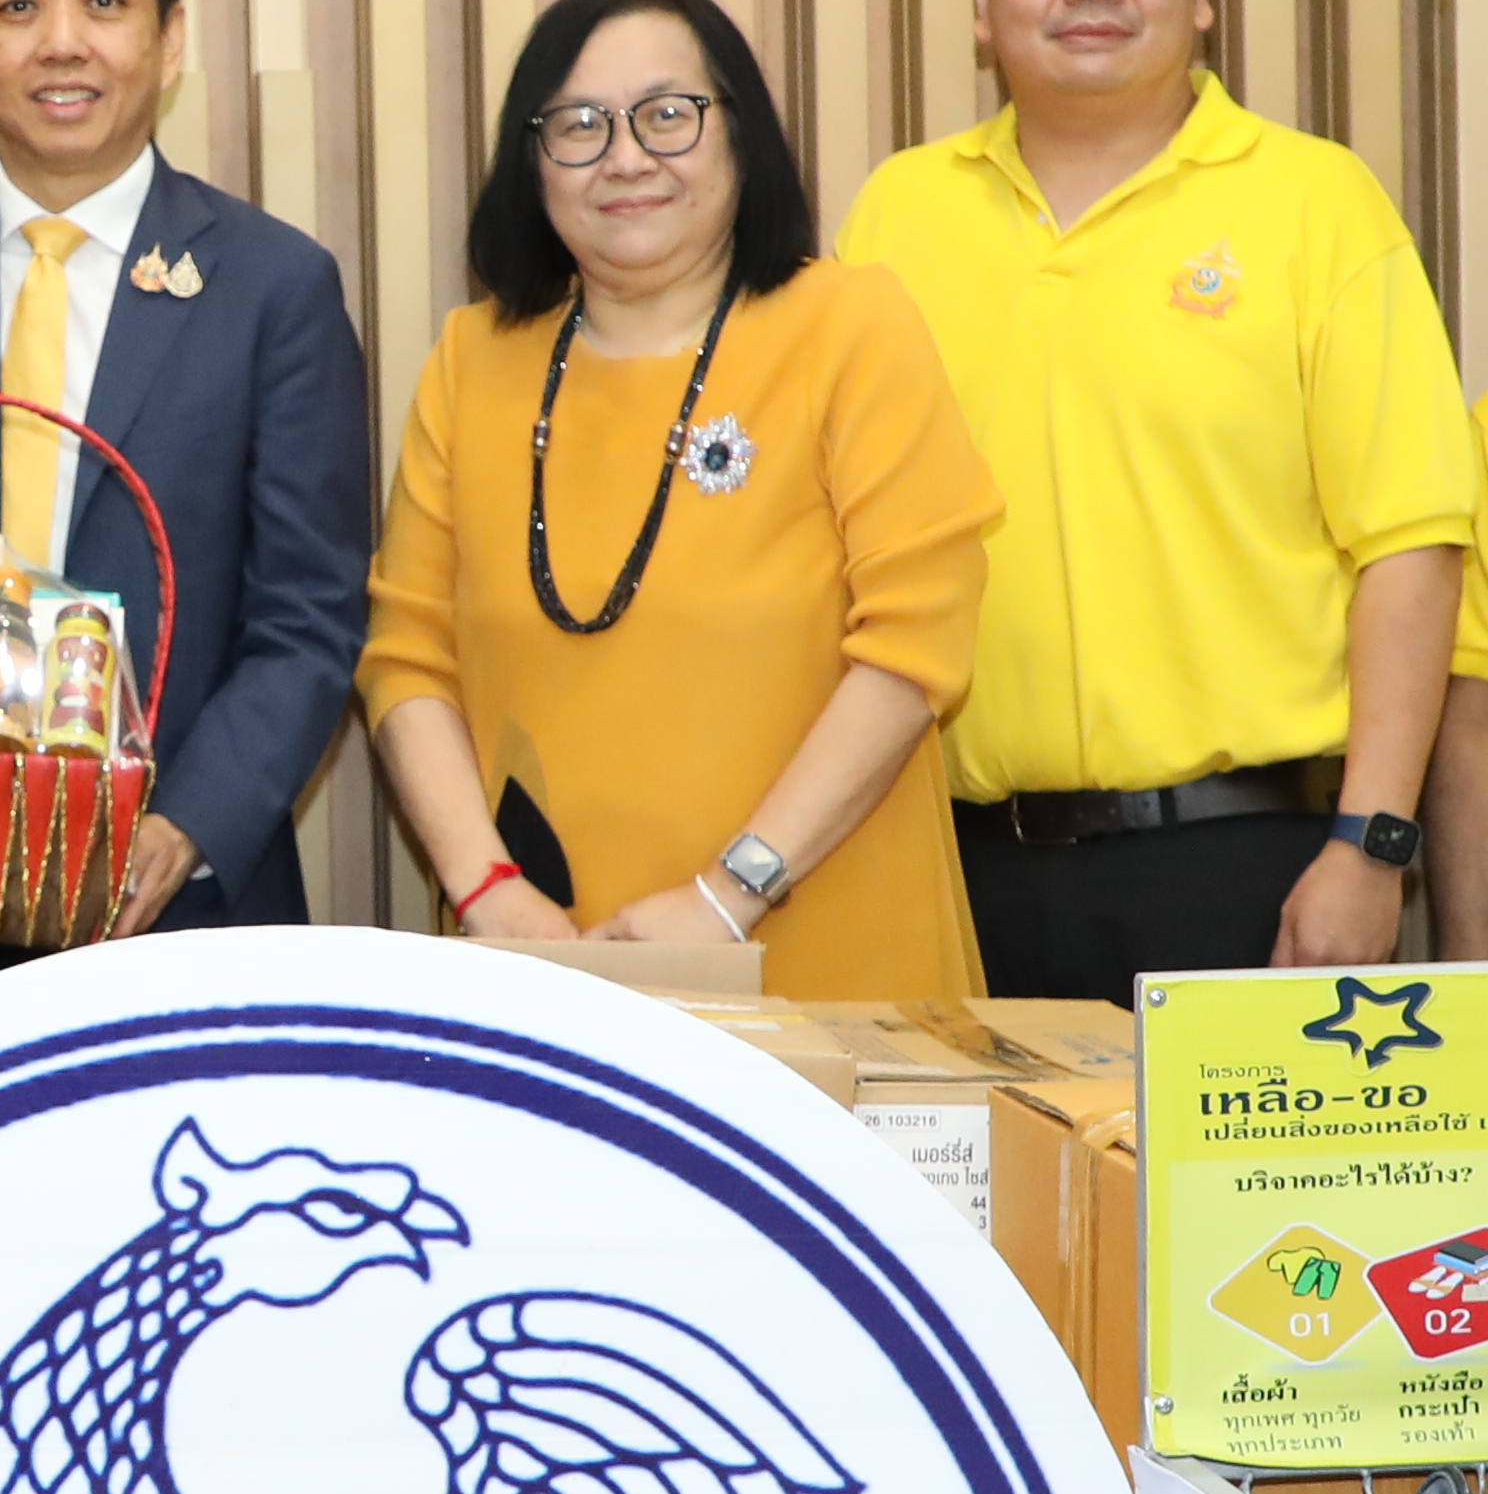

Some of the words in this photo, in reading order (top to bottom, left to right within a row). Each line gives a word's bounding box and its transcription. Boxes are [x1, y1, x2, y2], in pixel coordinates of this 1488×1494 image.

[1199, 1064, 1285, 1079] โครงการ
[888, 1114, 937, 1127] 103216
[1235, 1161, 1473, 1192] บริจาคอะไรได้บ้าง?
[971, 1195, 986, 1211] 44
[979, 1215, 988, 1230] 3
[1288, 1312, 1331, 1338] 01
[1424, 1308, 1472, 1335] 02
[1222, 1373, 1298, 1404] เสื้อผ้า
[1399, 1370, 1484, 1394] หนังสือ
[1224, 1411, 1295, 1433] ทุกเพศ
[1302, 1404, 1361, 1430] ทุกวัย
[1401, 1420, 1476, 1444] รองเท้า
[1227, 1434, 1343, 1457] ทุกประเภท
